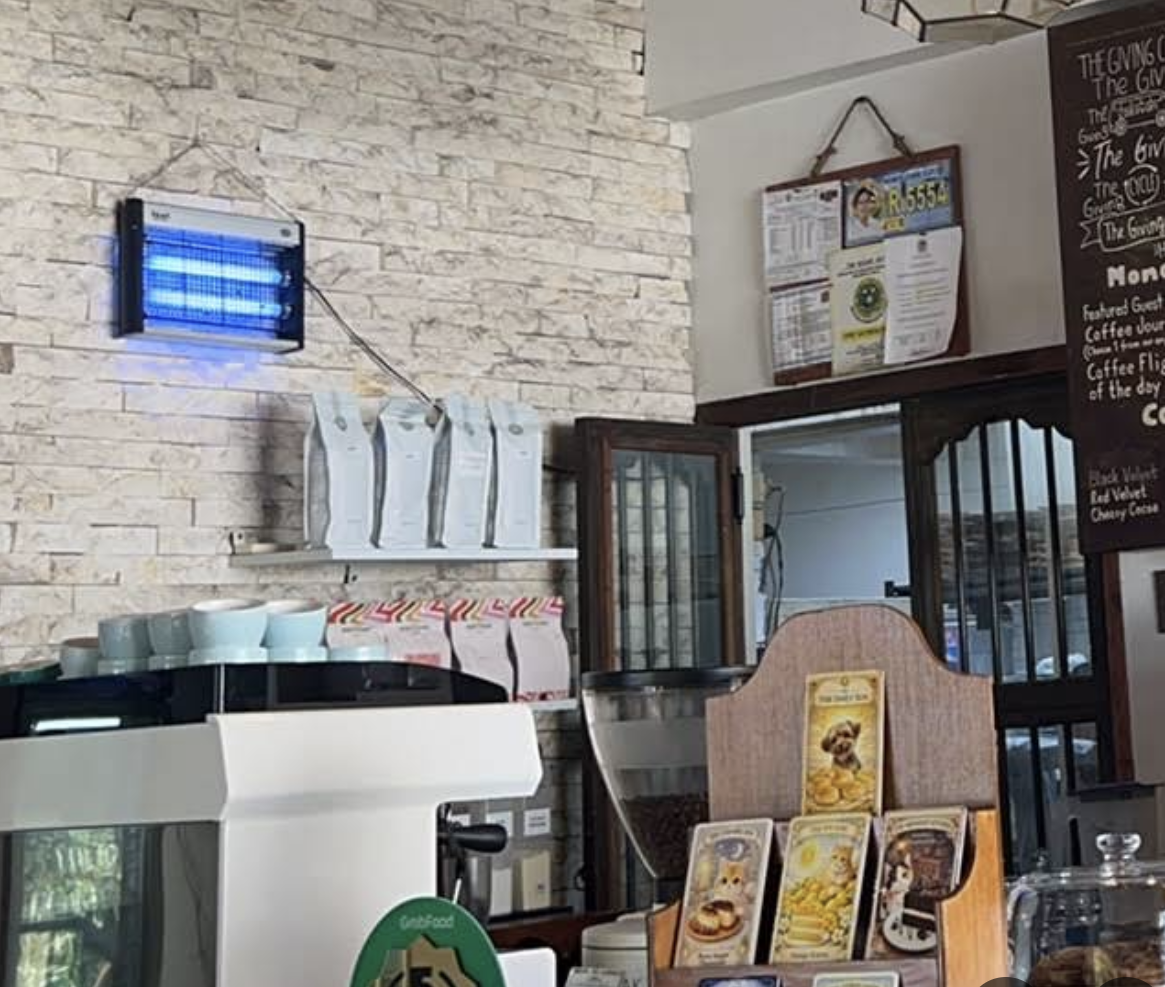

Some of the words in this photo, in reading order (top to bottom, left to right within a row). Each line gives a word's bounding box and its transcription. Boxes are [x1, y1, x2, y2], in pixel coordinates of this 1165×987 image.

[1094, 139, 1123, 180] The
[1103, 221, 1124, 241] The
[1085, 321, 1132, 343] Coffee
[1087, 360, 1134, 381] Coffee
[1089, 382, 1103, 401] of
[1109, 379, 1131, 399] the
[1137, 374, 1161, 398] day
[1112, 486, 1147, 502] Velvet
